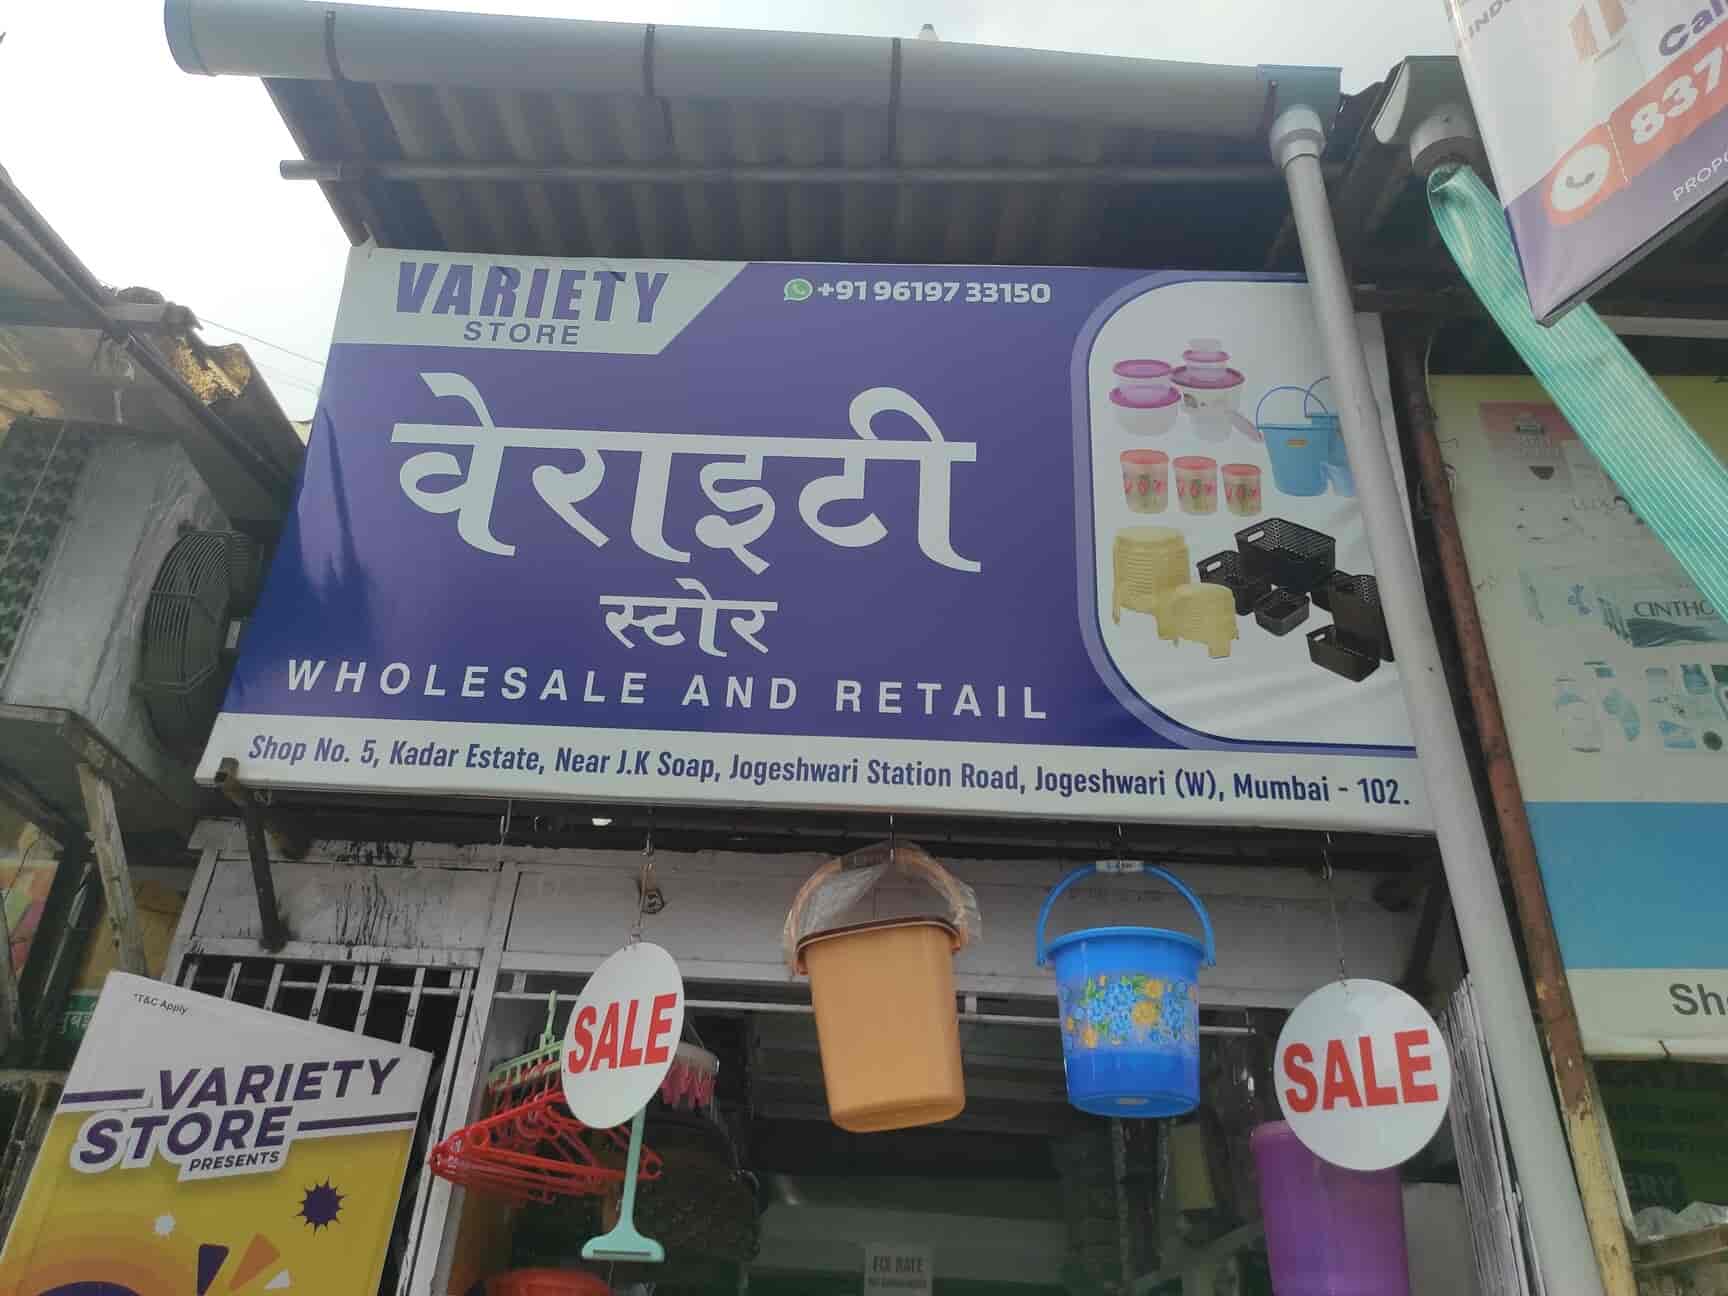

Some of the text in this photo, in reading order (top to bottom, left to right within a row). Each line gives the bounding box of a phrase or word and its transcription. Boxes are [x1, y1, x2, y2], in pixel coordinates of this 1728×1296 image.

[1469, 0, 1512, 38] IND
[1658, 0, 1728, 56] Cal
[1630, 44, 1728, 145] 837
[396, 261, 669, 324] VARIETY
[817, 280, 1051, 304] +91 96197 33150
[463, 320, 580, 346] STORE
[391, 372, 982, 575] वेराइटी
[599, 577, 778, 657] स्टोर
[287, 659, 1048, 720] WHOLESALE AND RETAIL
[248, 735, 307, 766] Shop
[314, 736, 350, 764] No.
[360, 739, 380, 768] 5,
[389, 740, 460, 769] Kadar
[465, 743, 546, 775] Estate,
[555, 746, 611, 776] Near
[616, 749, 651, 776] J.K
[657, 751, 721, 784] Soap,
[729, 754, 859, 786] Jogeshwari
[867, 759, 952, 788] Station
[960, 762, 1026, 795] Road,
[1034, 765, 1166, 798] Jogeshwari
[1174, 768, 1225, 802] (W),
[1233, 772, 1330, 802] Mumbai
[1356, 777, 1411, 806] 102.
[160, 998, 189, 1016] Apply
[1669, 983, 1728, 1016] Sh
[568, 992, 678, 1074] SALE
[158, 1056, 401, 1111] VARIETY
[1282, 1028, 1440, 1114] SALE
[79, 1105, 294, 1165] STORE
[188, 1151, 281, 1172] PRESENTS
